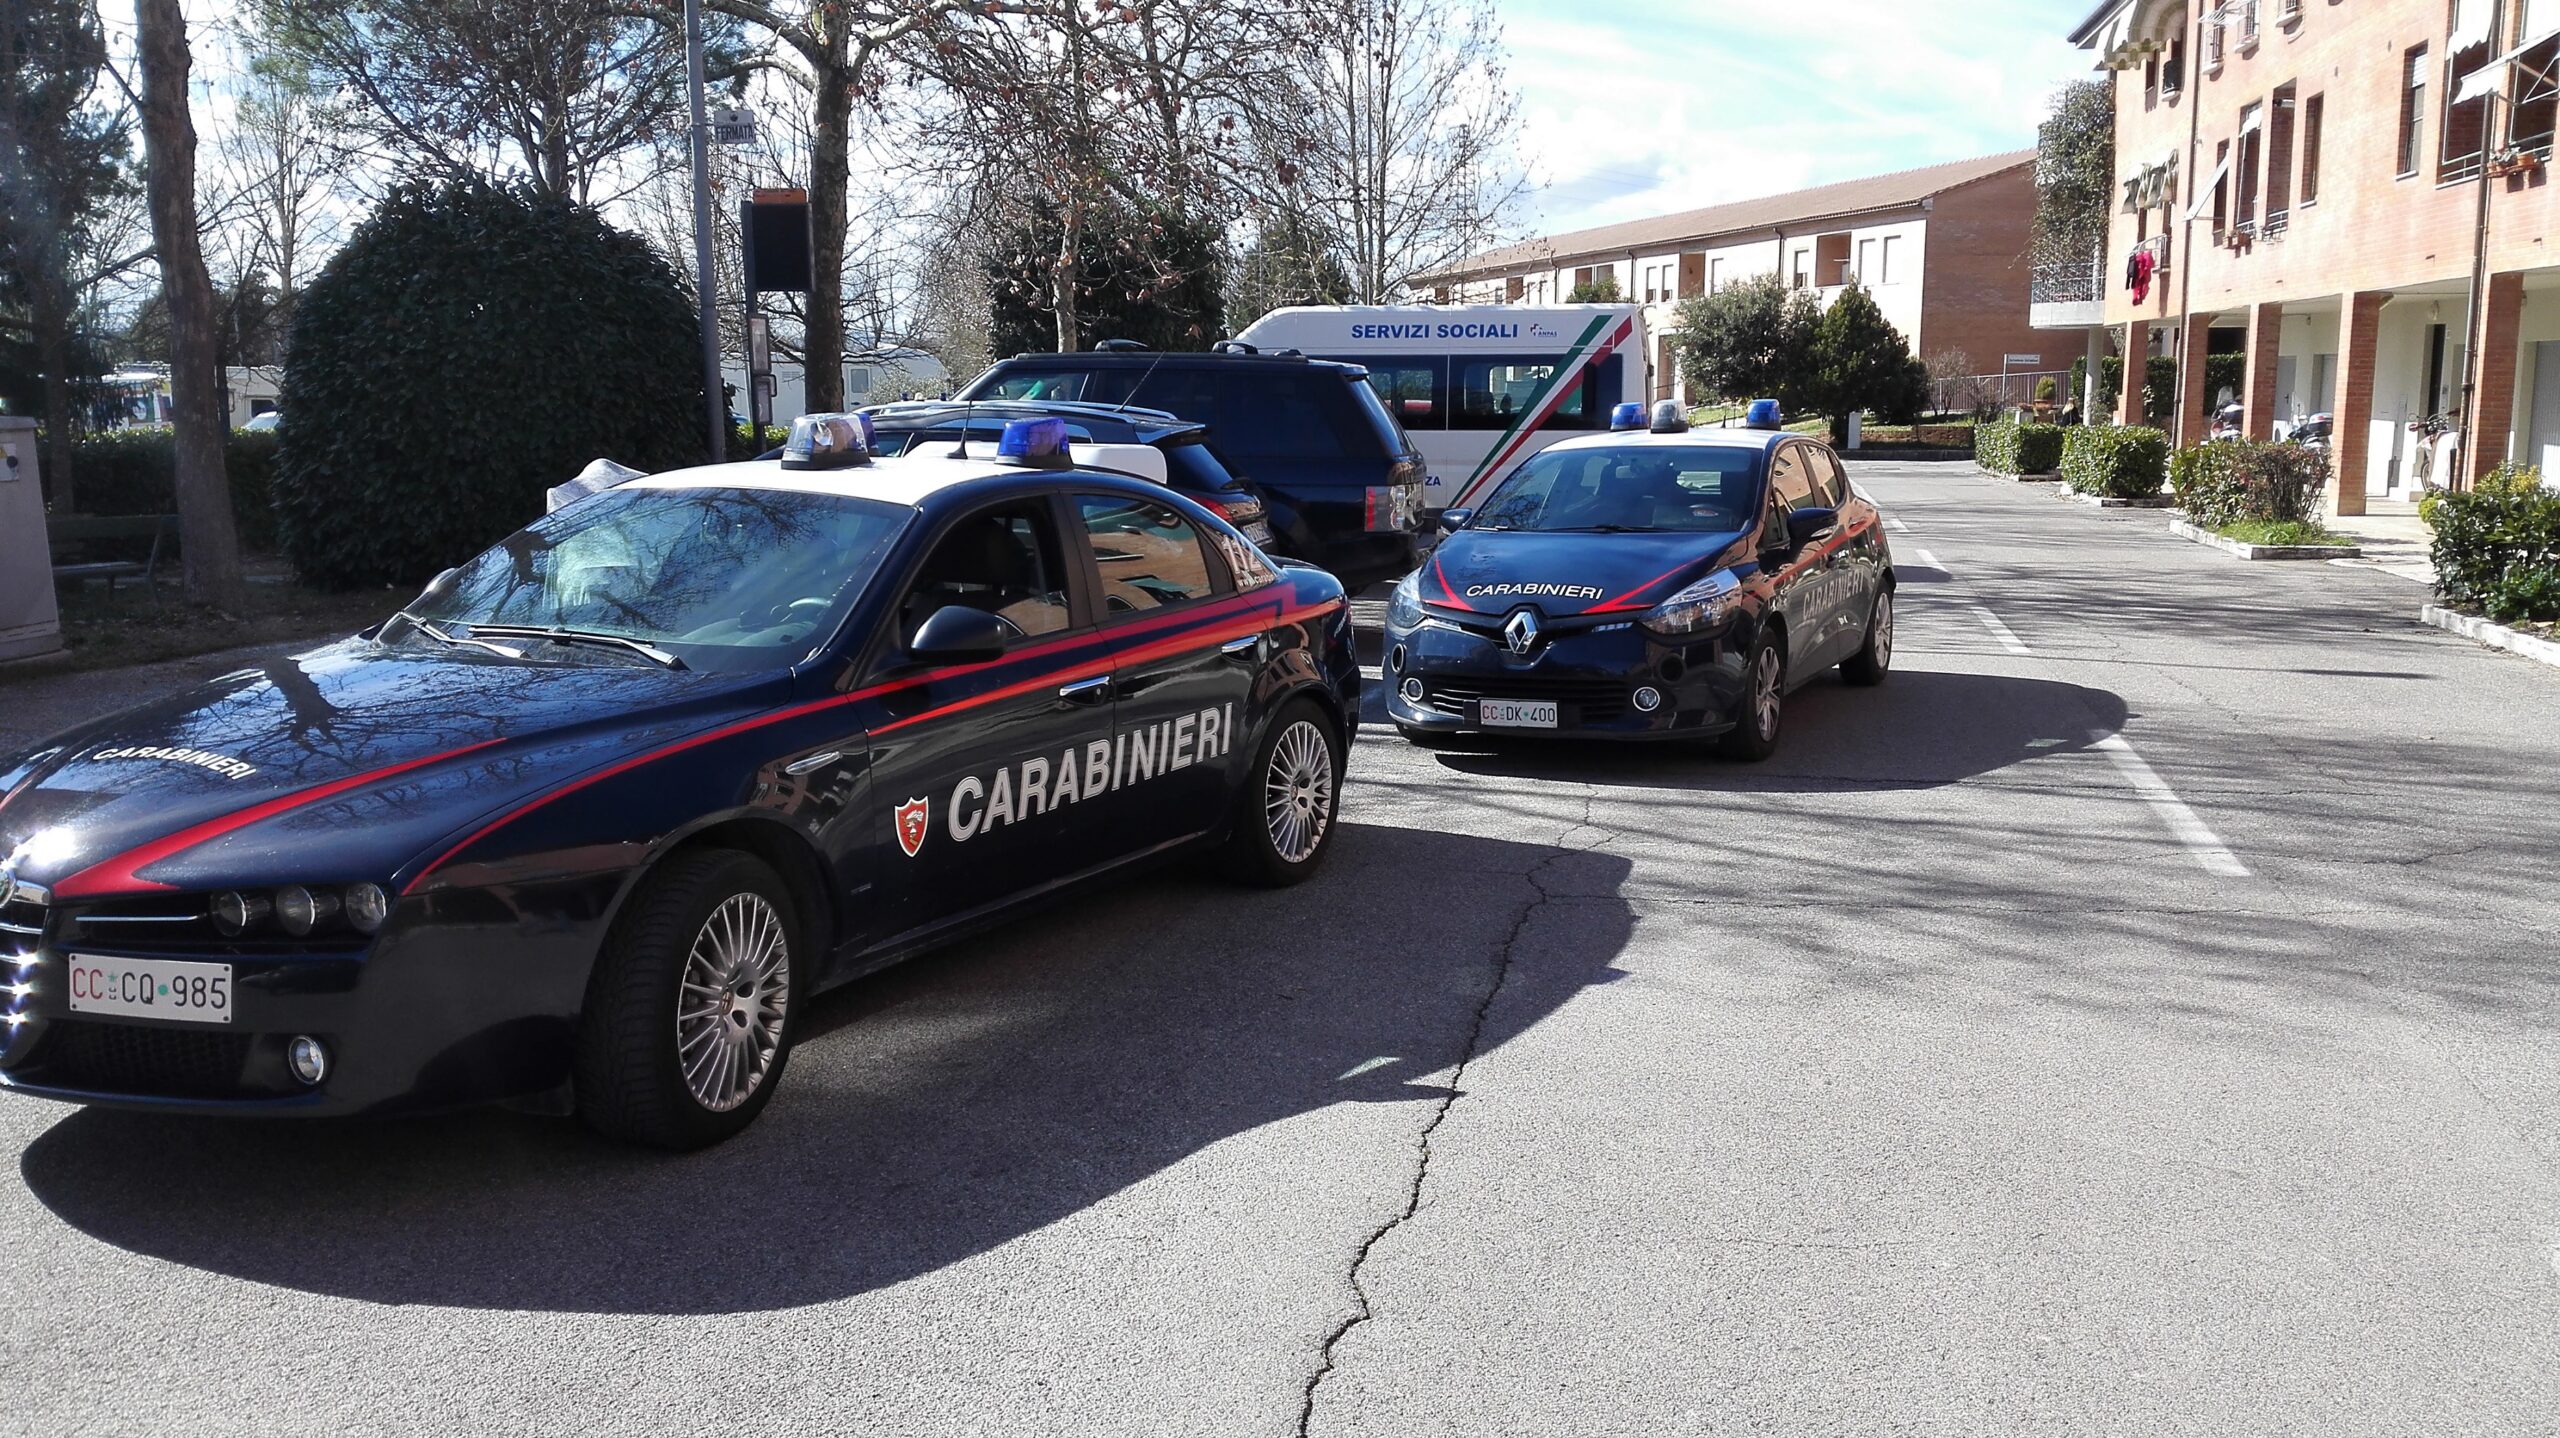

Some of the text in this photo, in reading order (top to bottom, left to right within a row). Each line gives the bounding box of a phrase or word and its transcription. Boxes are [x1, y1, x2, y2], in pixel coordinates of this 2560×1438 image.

[1351, 323, 1518, 339] SERVIZI SOCIALI
[1465, 583, 1604, 600] CARABINIERI
[1802, 569, 1864, 621] CARABINIERI
[1482, 705, 1499, 720] CC
[1506, 706, 1523, 721] DK
[1530, 707, 1556, 722] 400
[92, 746, 257, 780] CARABINIERI
[948, 702, 1233, 842] CARABINIERI
[72, 967, 226, 1010] CC CQ 985
